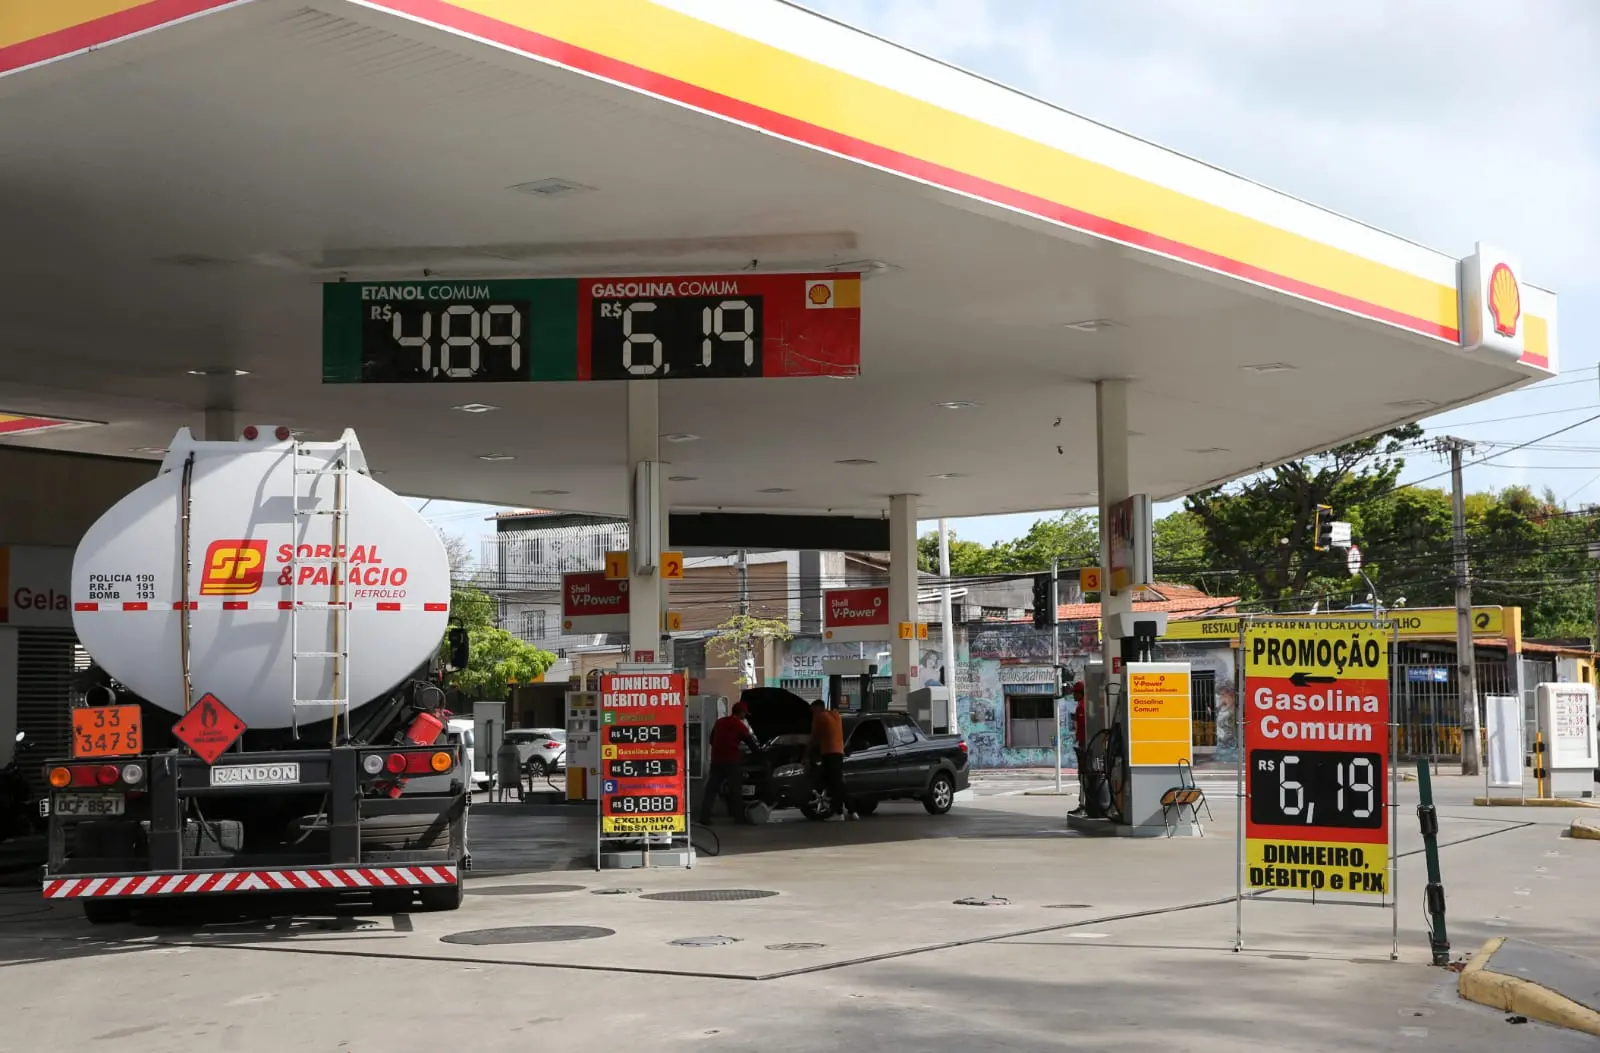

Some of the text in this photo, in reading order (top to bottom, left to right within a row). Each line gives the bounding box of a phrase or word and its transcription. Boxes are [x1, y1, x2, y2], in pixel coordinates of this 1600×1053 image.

[361, 285, 490, 300] ETANOL COMUM
[591, 281, 738, 298] GASOLINA COMUM
[371, 304, 392, 322] R$
[601, 300, 622, 319] R$
[209, 548, 261, 579] SP
[611, 562, 619, 577] 1
[667, 561, 679, 577] 2
[89, 574, 155, 582] POLICIA 190
[277, 563, 408, 586] & PALÁCIO
[1087, 574, 1097, 589] 3
[136, 582, 155, 591] 191
[570, 583, 590, 594] Shell
[13, 587, 71, 611] Gela
[89, 591, 155, 600] BOMB 193
[572, 595, 622, 607] V-Power
[831, 598, 849, 608] Shell
[832, 608, 876, 619] V-Power
[904, 627, 910, 636] 7
[1253, 633, 1380, 675] PROMOÇÃO
[611, 676, 673, 691] DINHEIRO,
[603, 691, 681, 707] DÉBITO e PIX
[1254, 687, 1379, 713] Gasolina
[94, 709, 120, 728] 33
[604, 712, 612, 723] E
[622, 726, 661, 743] 4,89
[1260, 715, 1372, 742] Comum
[81, 732, 137, 753] 3475
[604, 747, 613, 757] G
[1258, 759, 1275, 772] R$
[215, 766, 296, 783] RANDON
[604, 782, 613, 792] G
[623, 797, 674, 814] 8,888
[614, 816, 674, 824] EXCLUSIVO
[1263, 844, 1369, 870] DINHEIRO,
[1250, 864, 1383, 892] DÉBITO e PIX
